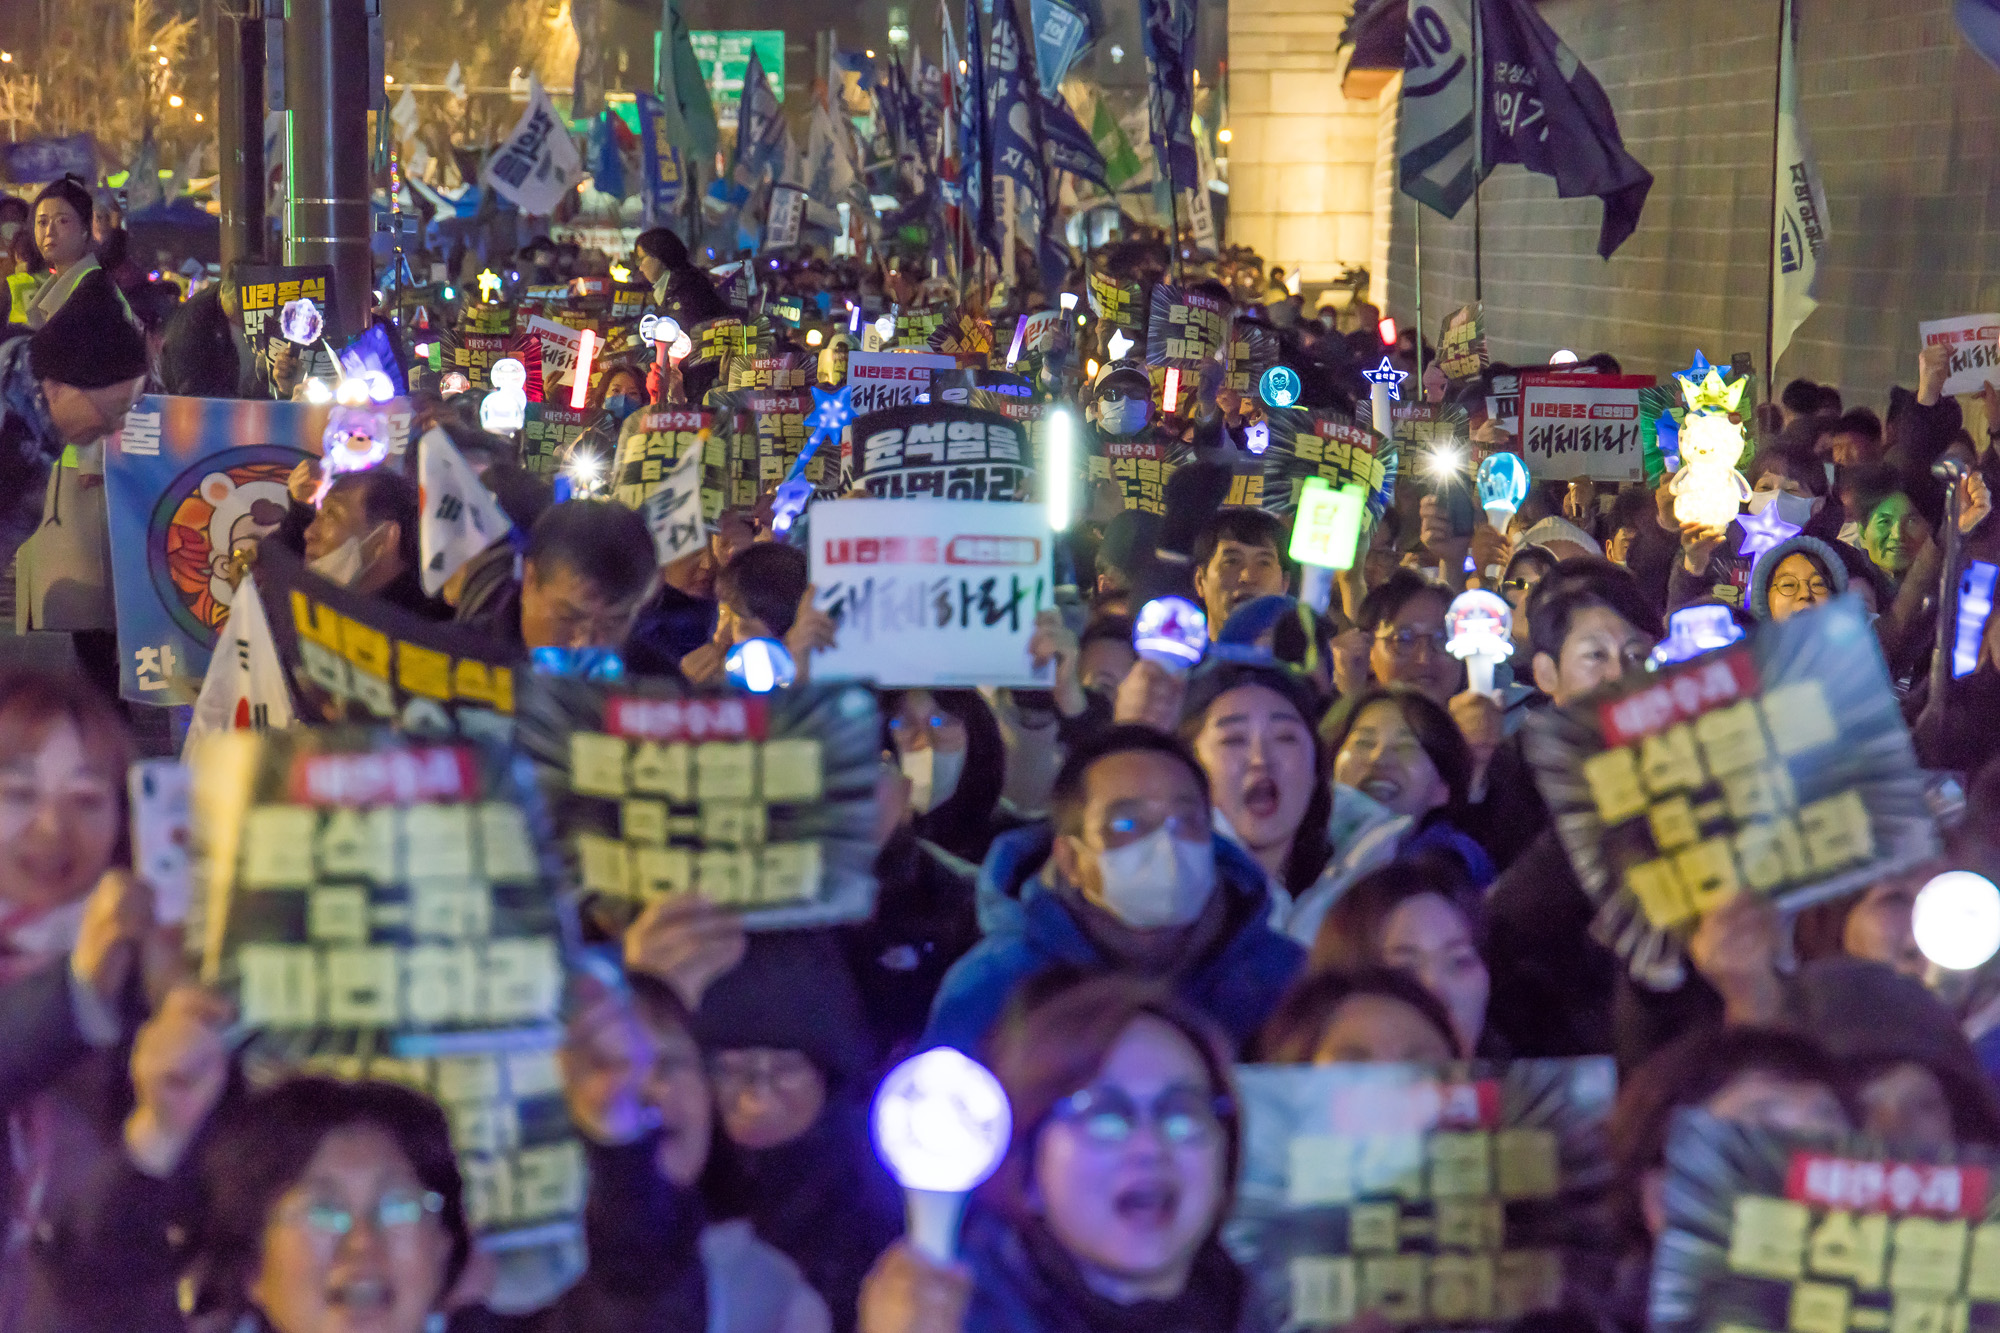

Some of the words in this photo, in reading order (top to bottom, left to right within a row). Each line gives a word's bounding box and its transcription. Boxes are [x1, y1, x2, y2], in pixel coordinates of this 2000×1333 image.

[242, 283, 276, 309] 내란
[853, 365, 908, 379] 내란동조
[1531, 402, 1587, 418] 내란동조
[864, 421, 1021, 474] 윤석열을
[1528, 423, 1640, 459] 해체하라!
[135, 645, 176, 690] 찬
